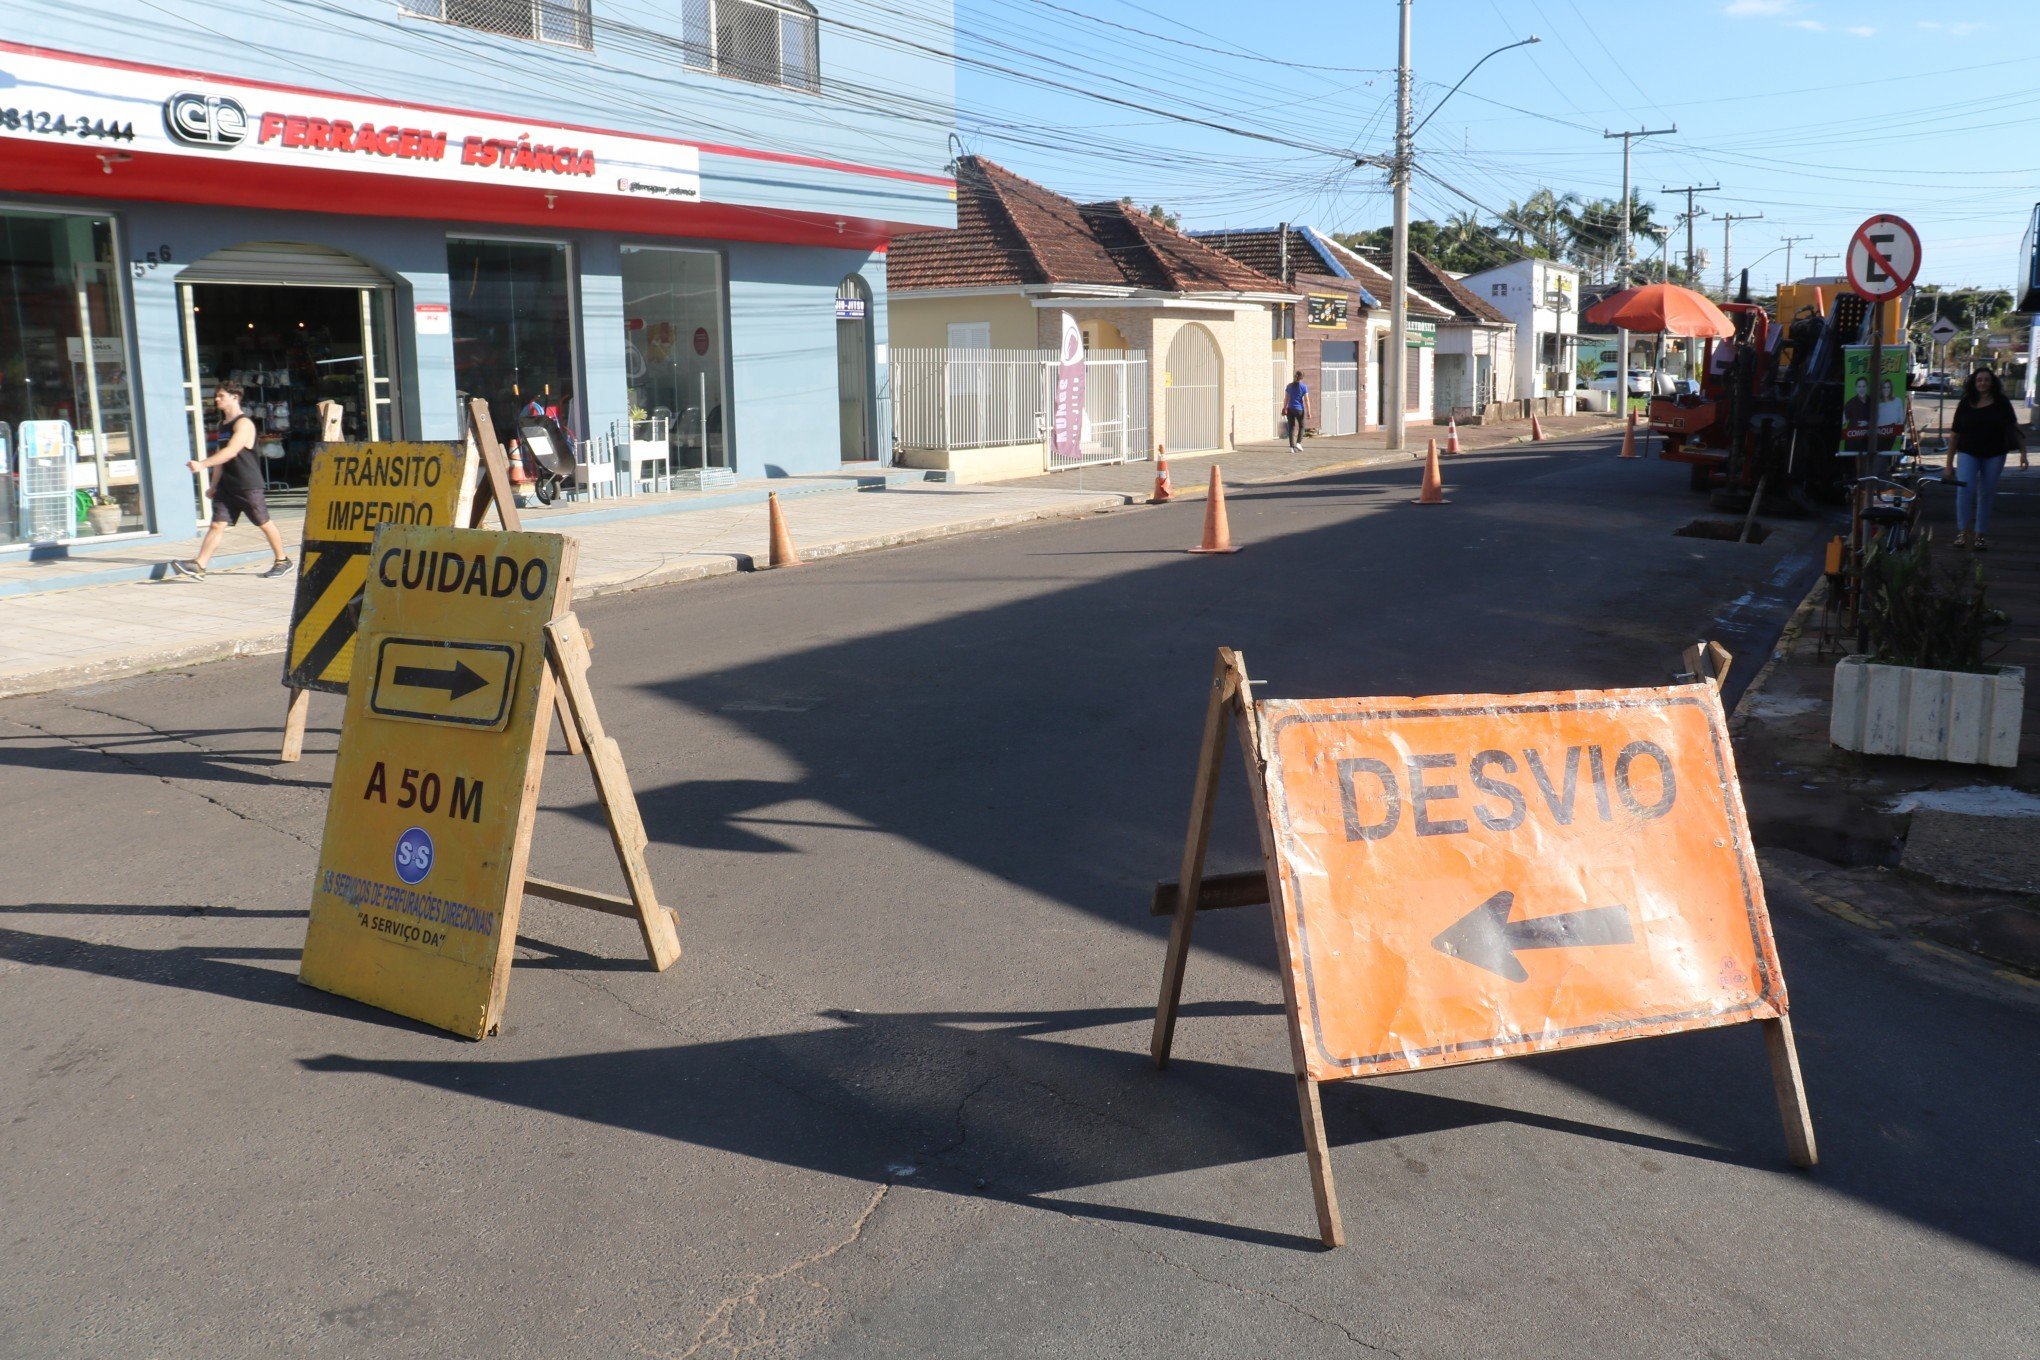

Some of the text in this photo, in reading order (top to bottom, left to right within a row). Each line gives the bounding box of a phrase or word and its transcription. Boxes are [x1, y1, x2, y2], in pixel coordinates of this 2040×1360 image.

[0, 107, 135, 144] 8124-3444
[257, 111, 447, 163] FERRAGEM
[133, 244, 172, 278] 556
[1866, 234, 1895, 283] E
[333, 448, 441, 488] TRÂNSITO
[326, 500, 433, 532] IMPEDIDO
[378, 547, 549, 602] CUIDADO
[363, 760, 484, 823] A 50 M
[1337, 739, 1677, 843] DESVIO
[371, 916, 420, 943] SERVIÇO
